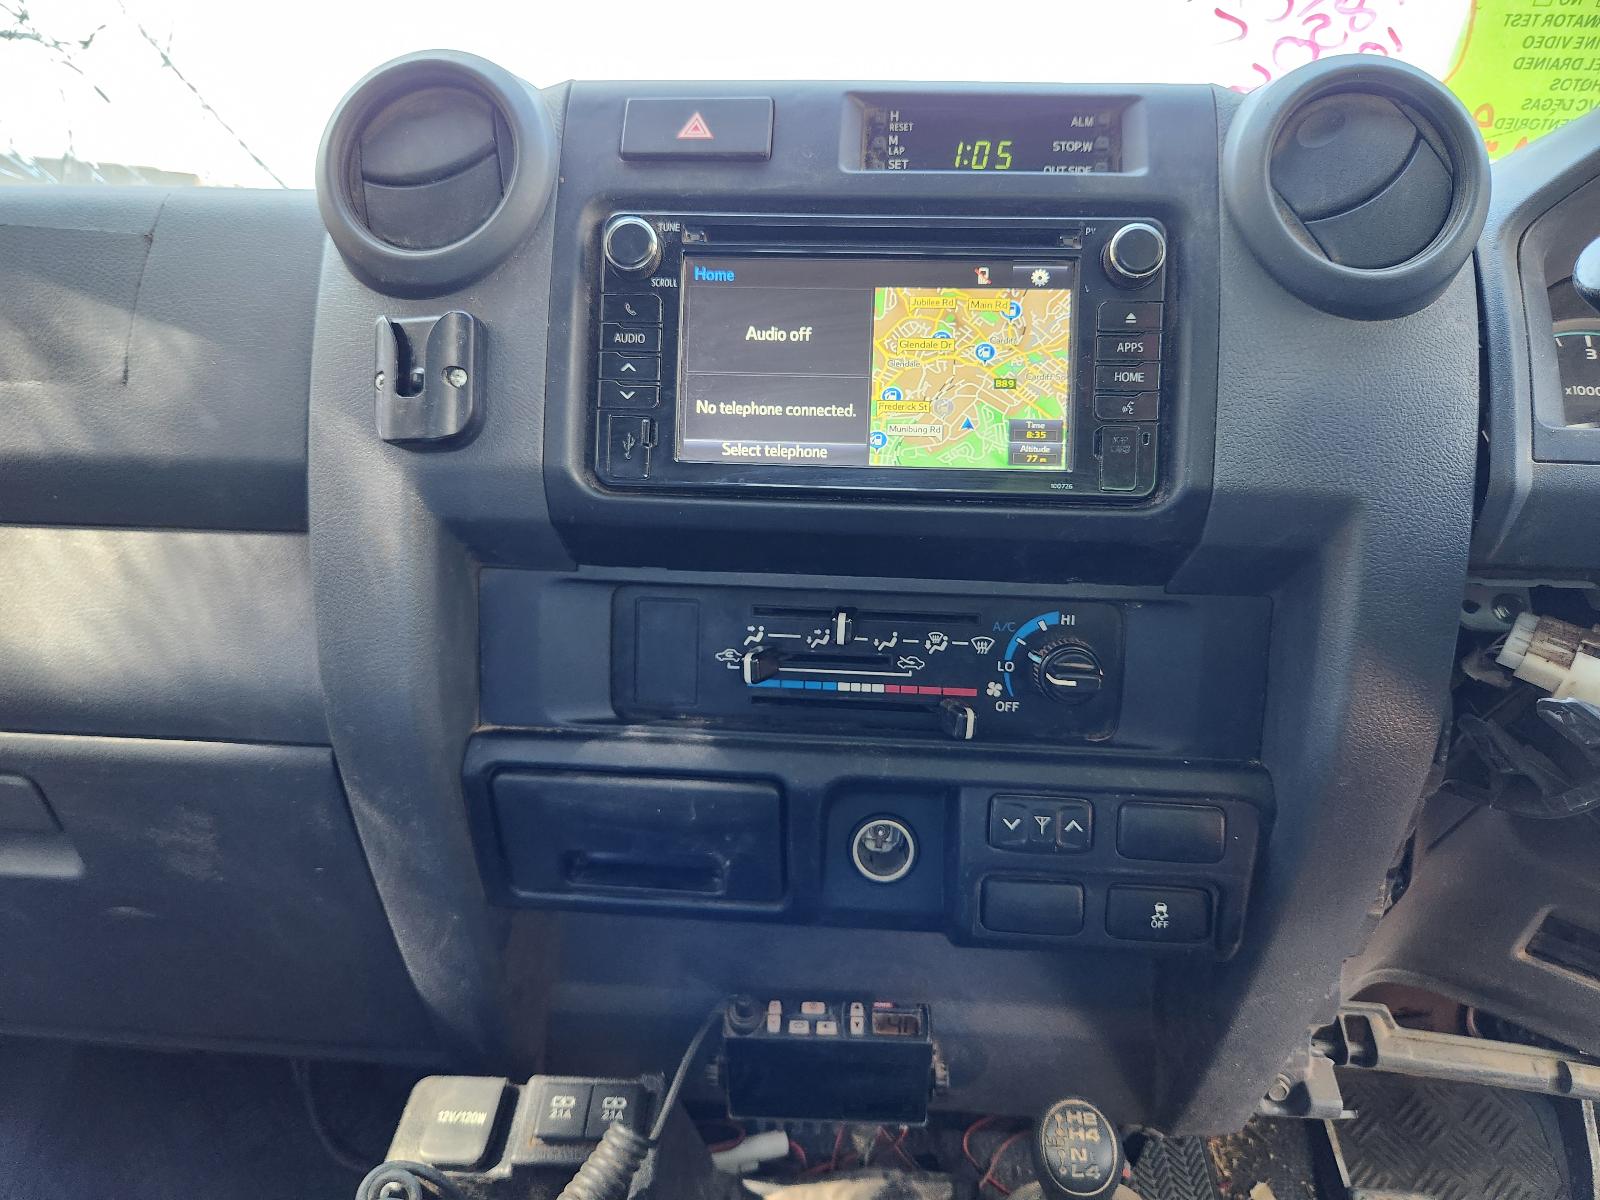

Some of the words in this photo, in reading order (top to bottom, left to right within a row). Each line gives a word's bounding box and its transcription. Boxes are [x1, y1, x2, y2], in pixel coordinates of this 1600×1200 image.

[890, 110, 900, 122] H
[889, 123, 914, 132] RESET
[1071, 116, 1095, 128] ALM
[888, 135, 899, 146] M
[888, 146, 905, 156] LAP
[954, 140, 1013, 171] 1:05
[888, 159, 909, 170] SET
[658, 222, 680, 233] TUNE
[694, 265, 735, 283] Home
[651, 277, 678, 288] SCROLL
[913, 299, 940, 308] Jubilee
[942, 299, 954, 307] Rd
[970, 300, 993, 310] Main
[995, 300, 1008, 310] Rd
[614, 332, 646, 344] AUDIO
[745, 325, 787, 342] Audio
[789, 326, 813, 342] off
[899, 340, 938, 350] Glendale
[940, 341, 952, 349] Dr
[1116, 342, 1144, 353] APPS
[1585, 348, 1598, 360] 3
[887, 358, 921, 368] Glendale
[1114, 371, 1145, 383] HOME
[696, 399, 717, 415] No
[719, 400, 783, 418] telephone
[785, 403, 857, 418] connected.
[878, 402, 916, 411] Frederick
[919, 403, 927, 411] St
[889, 425, 928, 435] Munibung
[929, 426, 941, 434] Rd
[1026, 420, 1046, 429] Time
[721, 442, 762, 458] Select
[764, 443, 828, 461] telephone
[1020, 445, 1051, 453] Altitude
[1026, 454, 1039, 463] 77
[1060, 614, 1076, 626] HI
[992, 621, 1016, 632] A/C
[997, 661, 1015, 672] LO
[995, 701, 1020, 713] OFF
[1150, 920, 1169, 929] OFF
[1070, 1147, 1088, 1163] N
[1071, 1164, 1101, 1179] L4
